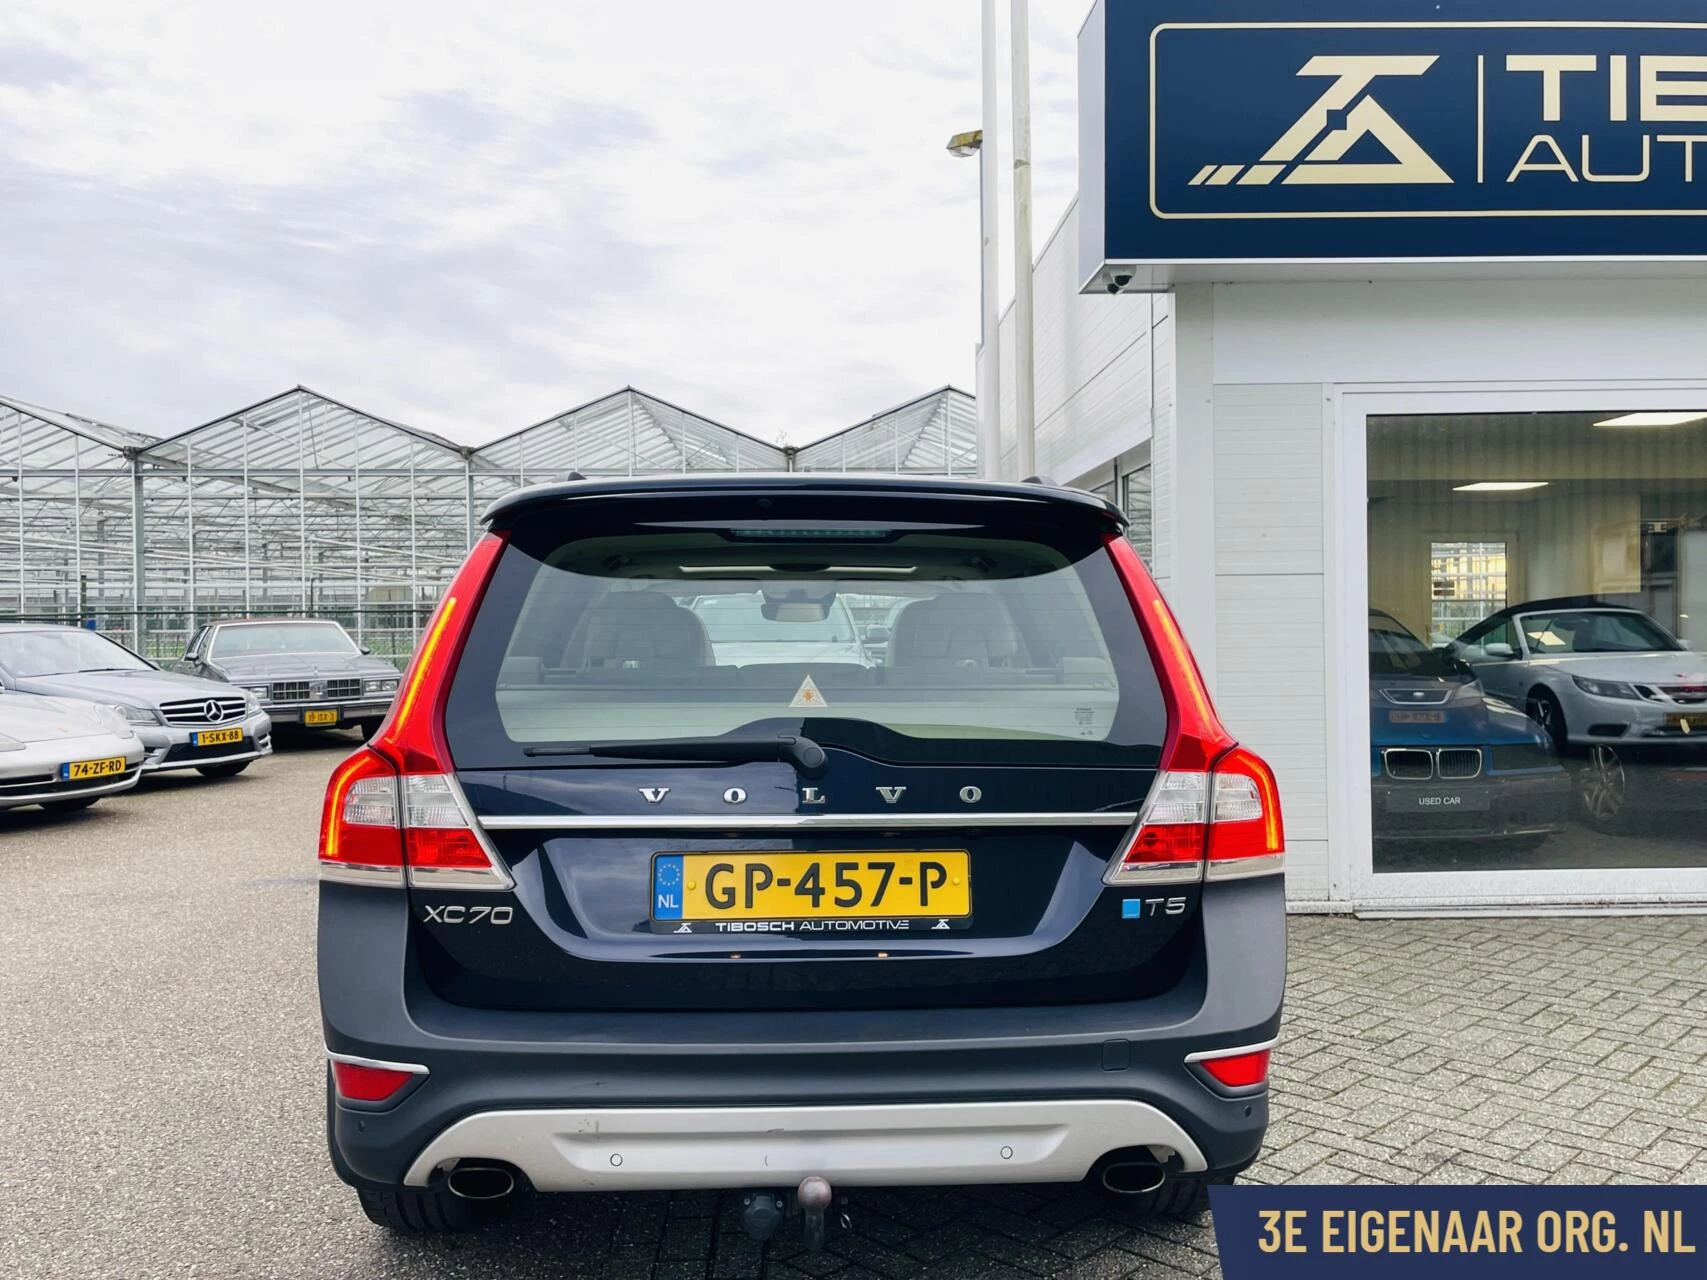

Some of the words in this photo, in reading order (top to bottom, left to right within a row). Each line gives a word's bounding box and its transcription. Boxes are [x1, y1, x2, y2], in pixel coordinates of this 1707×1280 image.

[1506, 134, 1707, 183] AUT
[202, 730, 239, 744] 1-SKX-88
[73, 759, 122, 777] 74-ZF-RD
[638, 787, 982, 805] VOLVO
[1418, 797, 1441, 806] USED
[1443, 796, 1461, 805] CAR
[705, 861, 947, 910] GP-457-P
[658, 894, 679, 909] NL
[1145, 896, 1186, 917] T5
[423, 905, 513, 925] XC70
[714, 921, 795, 932] TIBOSCH
[799, 919, 910, 931] AUTOMOTIVE
